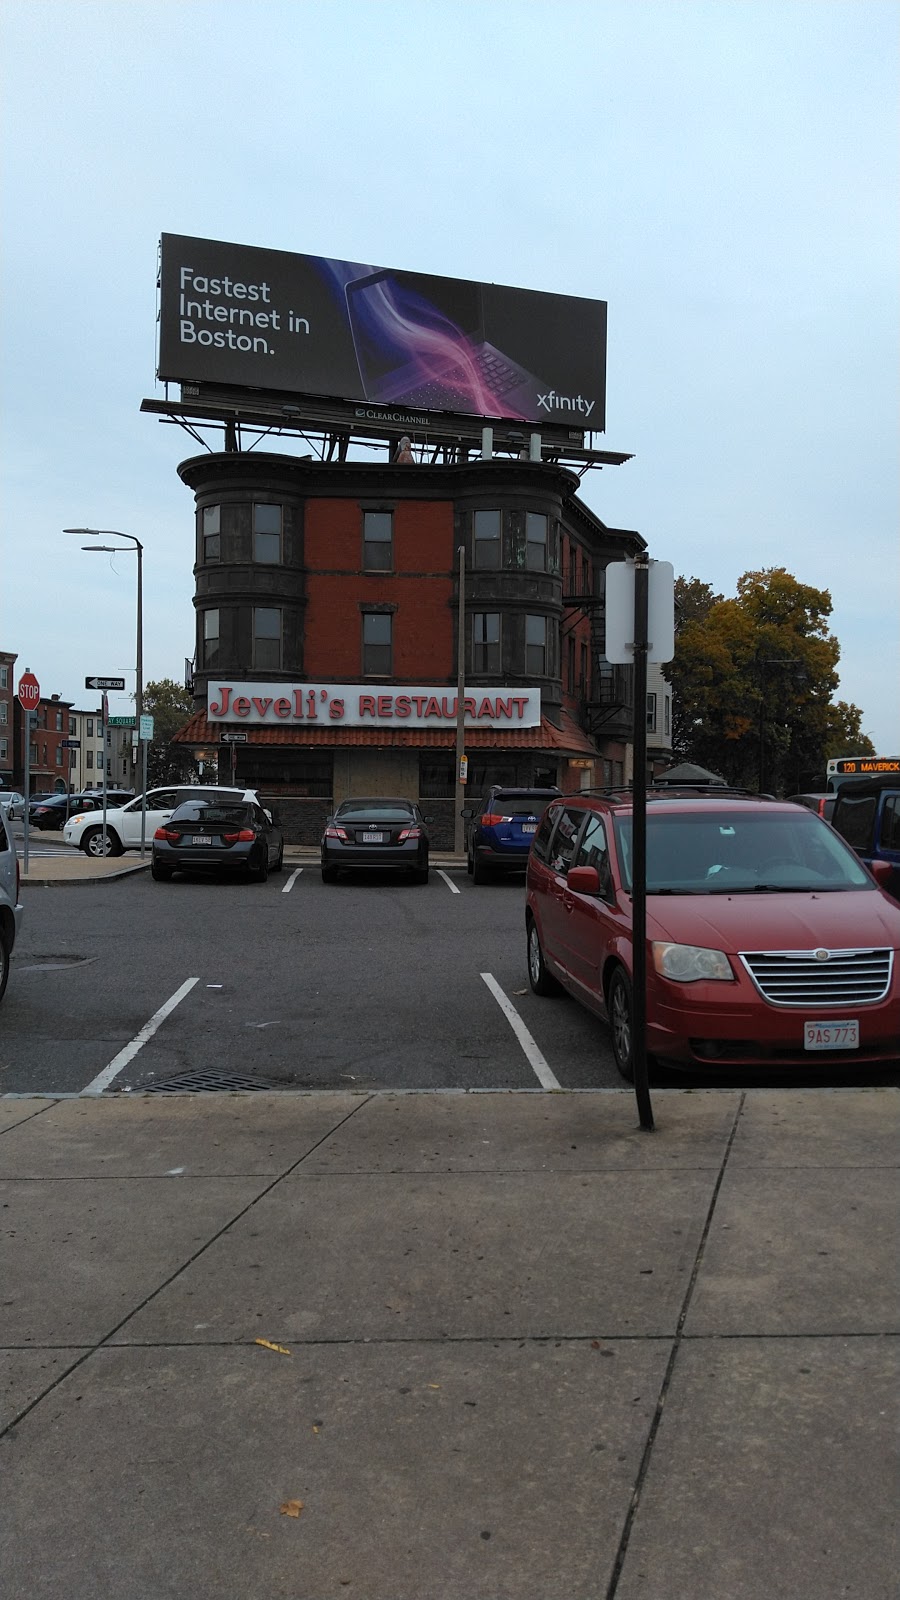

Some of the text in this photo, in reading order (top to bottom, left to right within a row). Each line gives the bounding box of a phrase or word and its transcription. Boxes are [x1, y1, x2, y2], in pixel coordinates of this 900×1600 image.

[180, 266, 271, 303] Fastest
[179, 293, 310, 334] Internet in
[180, 319, 275, 355] Boston.
[536, 390, 596, 416] xfinity
[20, 683, 39, 700] STOP
[210, 687, 529, 719] Jeveli's RESTAURANT
[843, 762, 900, 773] 120 MAVERICK
[807, 1028, 857, 1044] 9AS 773
